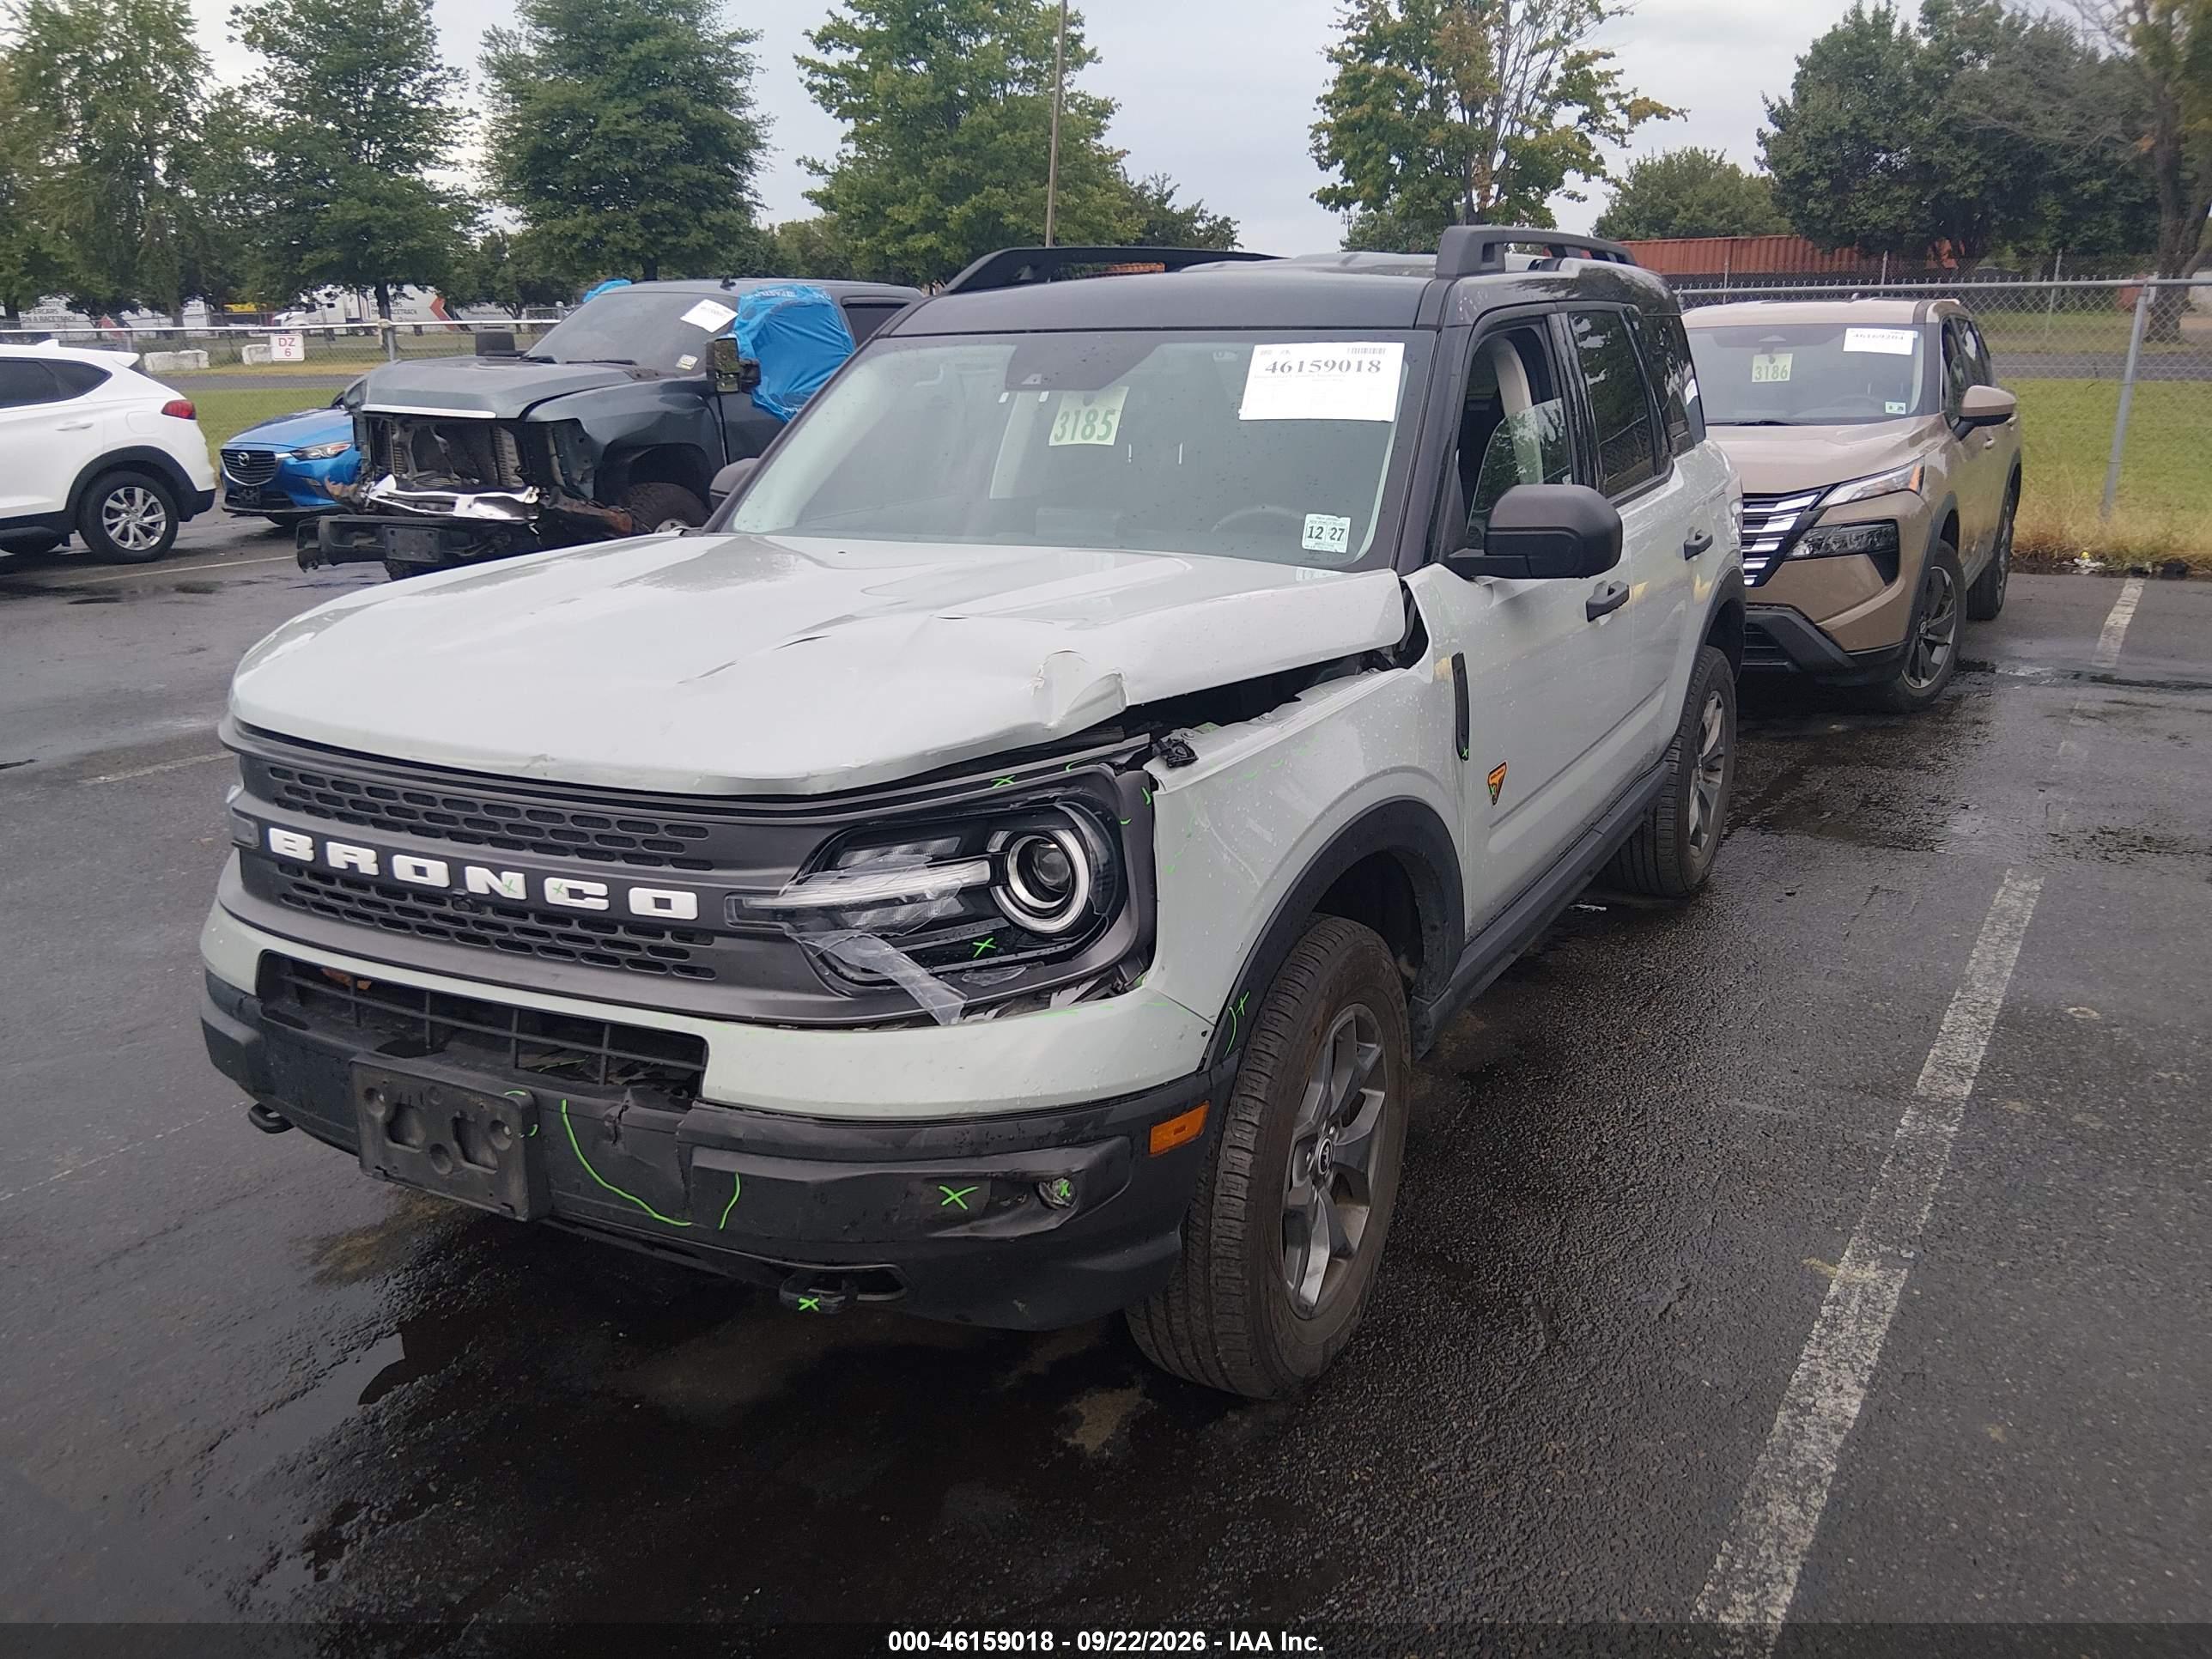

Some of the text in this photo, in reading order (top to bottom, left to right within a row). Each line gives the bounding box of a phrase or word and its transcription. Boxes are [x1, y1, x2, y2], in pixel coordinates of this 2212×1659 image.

[278, 337, 295, 347] DZ
[284, 348, 292, 357] 6
[1265, 360, 1382, 374] 46159018
[1755, 364, 1789, 380] 3186
[1054, 408, 1116, 442] 3185
[1307, 526, 1346, 542] 12 27
[268, 828, 699, 921] BRONCO
